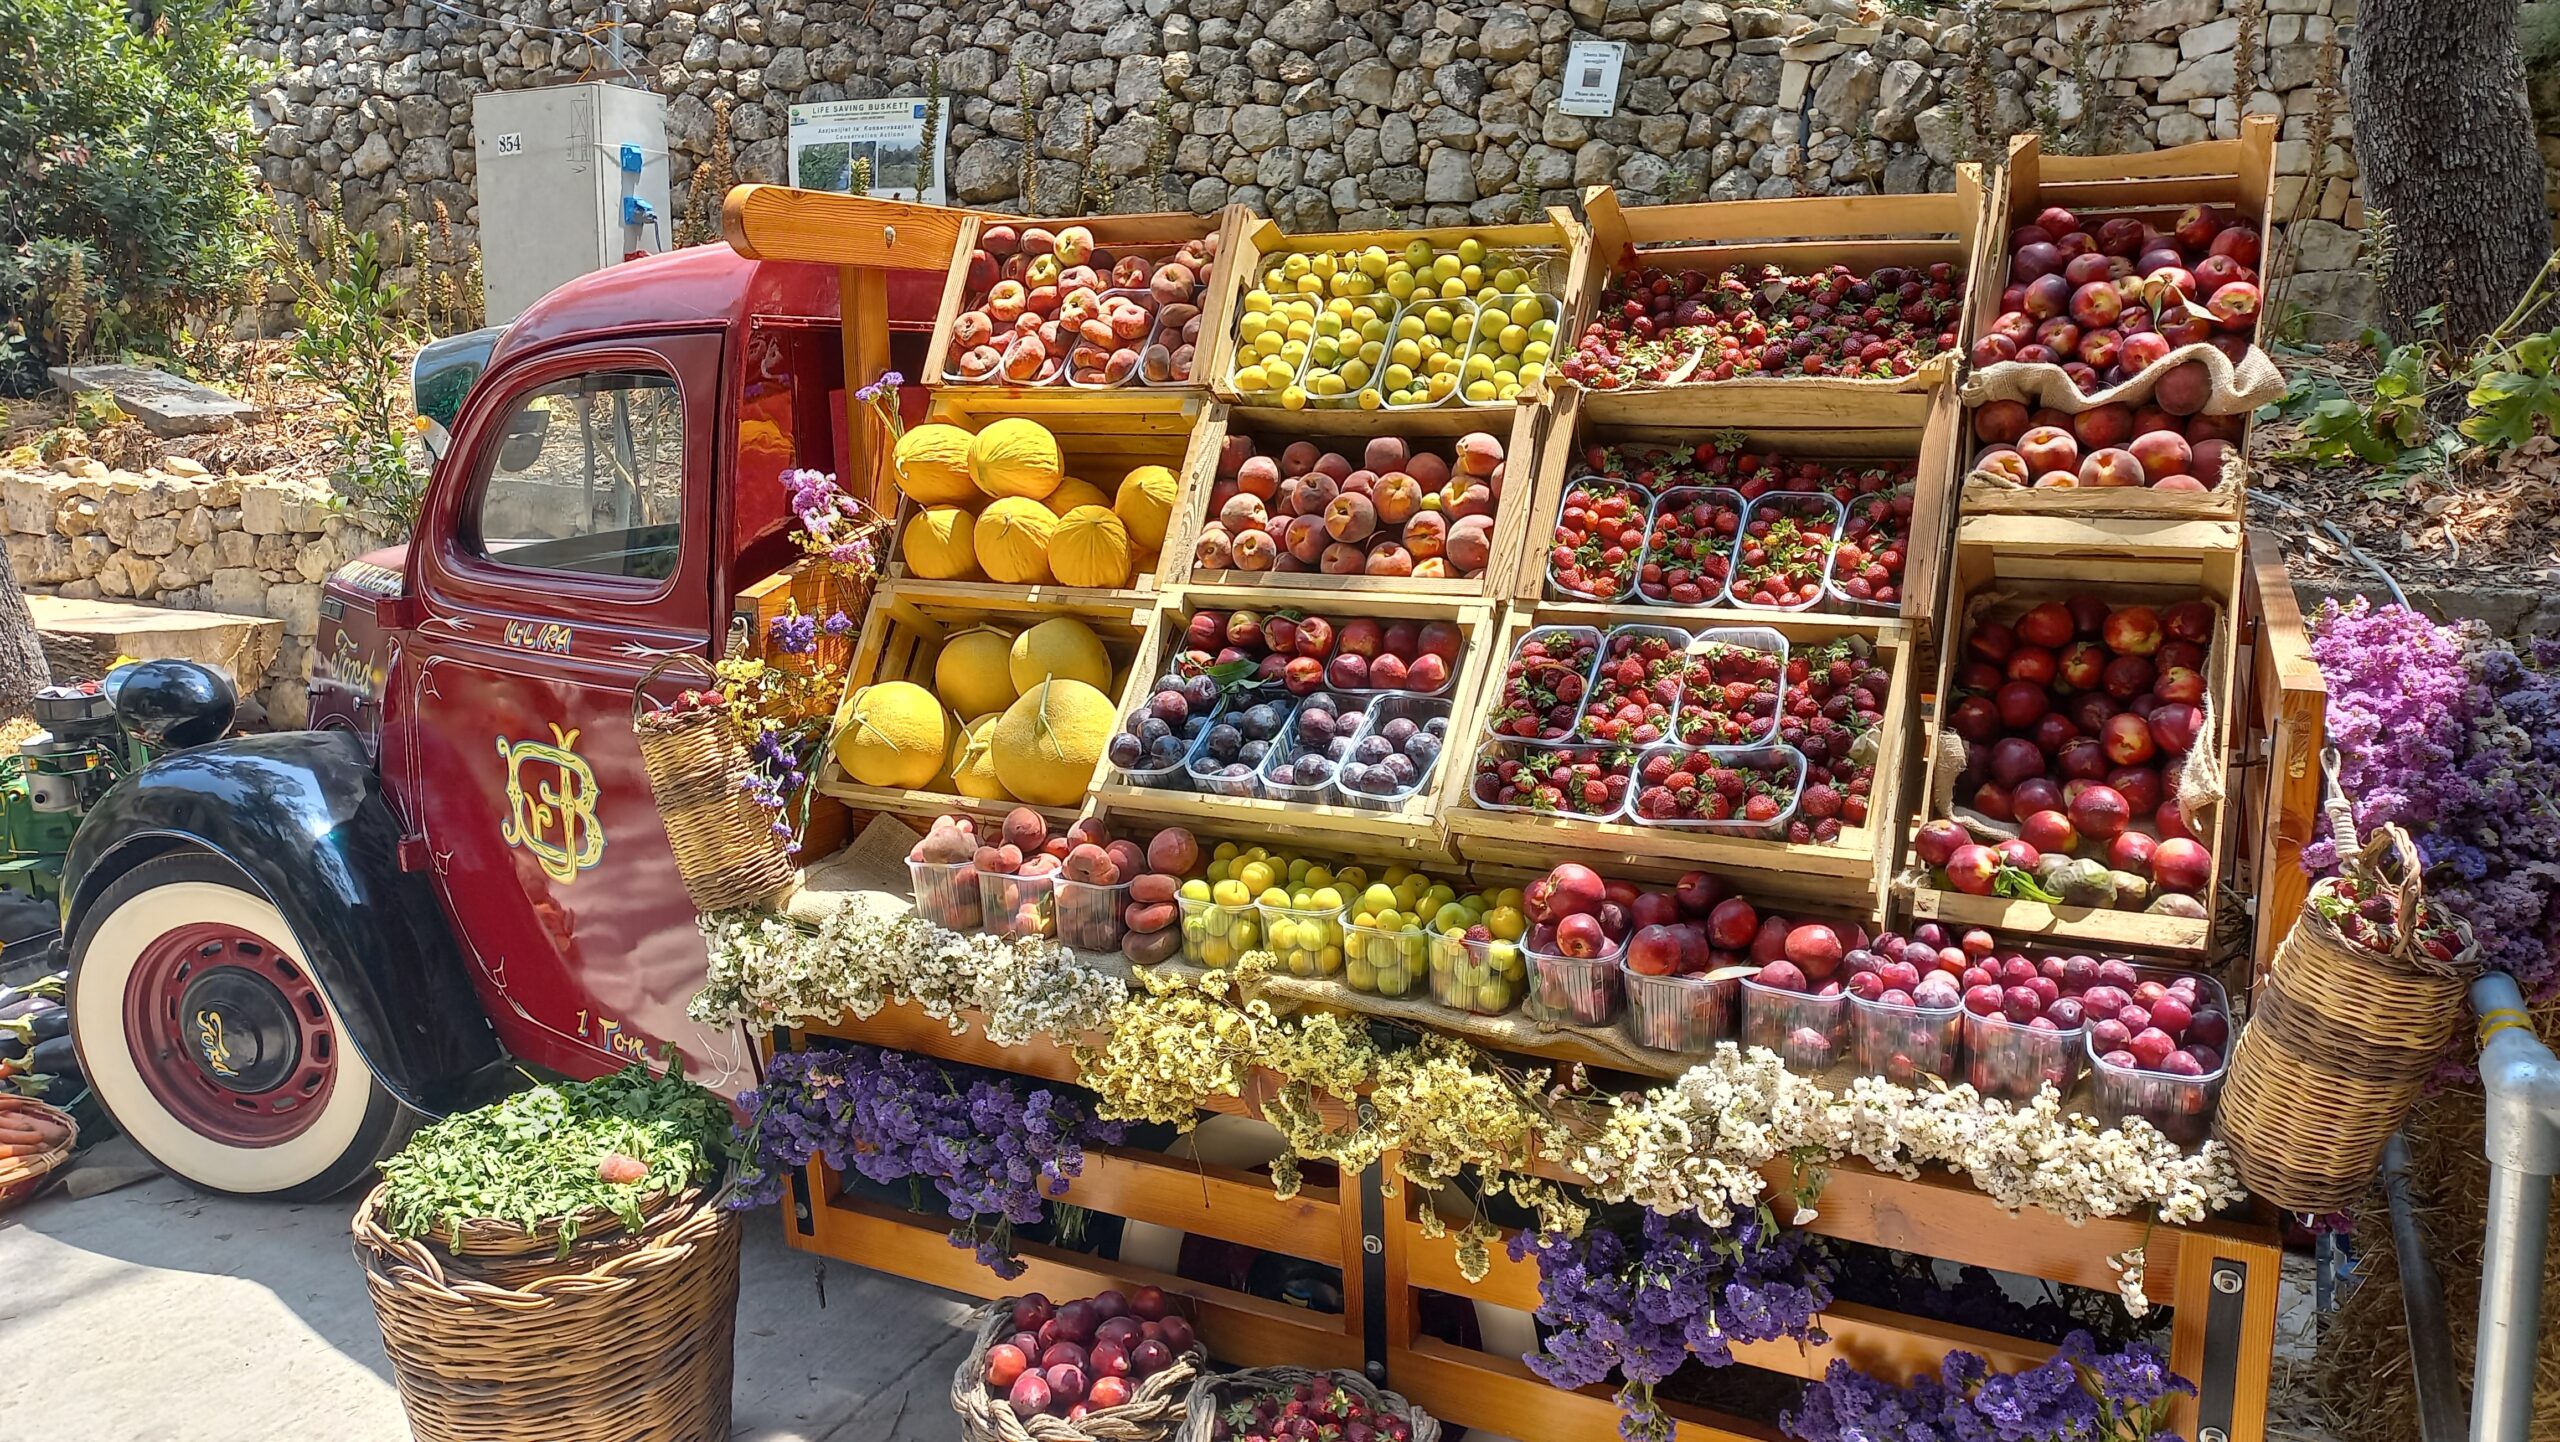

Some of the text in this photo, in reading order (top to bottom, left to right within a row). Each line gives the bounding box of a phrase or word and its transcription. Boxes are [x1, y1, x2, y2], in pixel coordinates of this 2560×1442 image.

[833, 104, 864, 113] SAVING
[868, 102, 909, 111] BUSKETT
[499, 134, 521, 153] 854
[331, 628, 375, 696] Ford
[196, 1010, 240, 1078] Ford
[576, 1009, 649, 1062] 1 Ton
